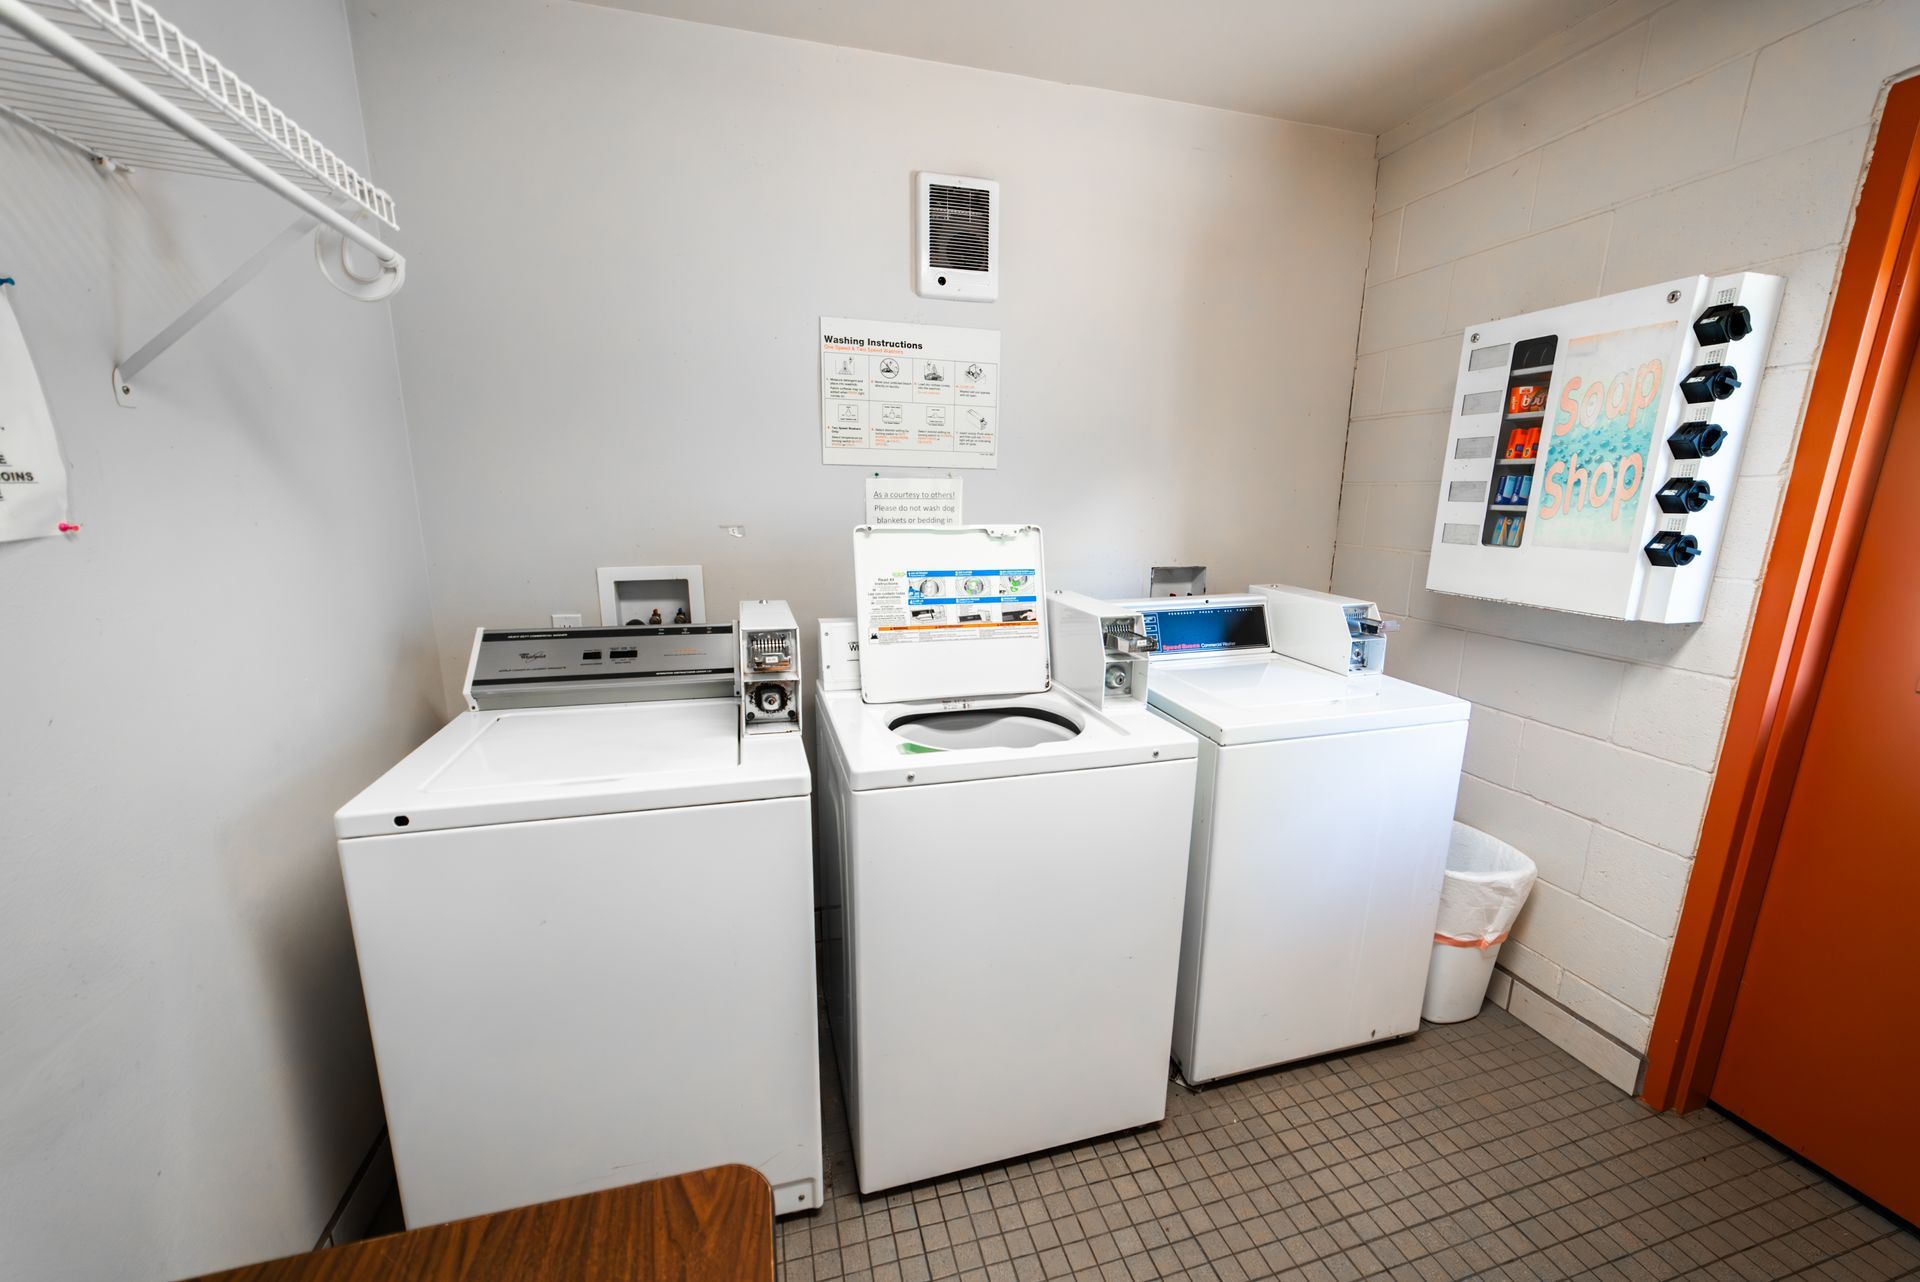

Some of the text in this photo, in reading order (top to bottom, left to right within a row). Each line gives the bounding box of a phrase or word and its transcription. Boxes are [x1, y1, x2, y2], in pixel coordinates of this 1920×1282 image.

[824, 335, 923, 350] Washing Instructions
[0, 471, 34, 482] OINS
[890, 492, 920, 500] courtesy
[874, 504, 955, 513] Please do not wash dog
[917, 517, 945, 525] bedding
